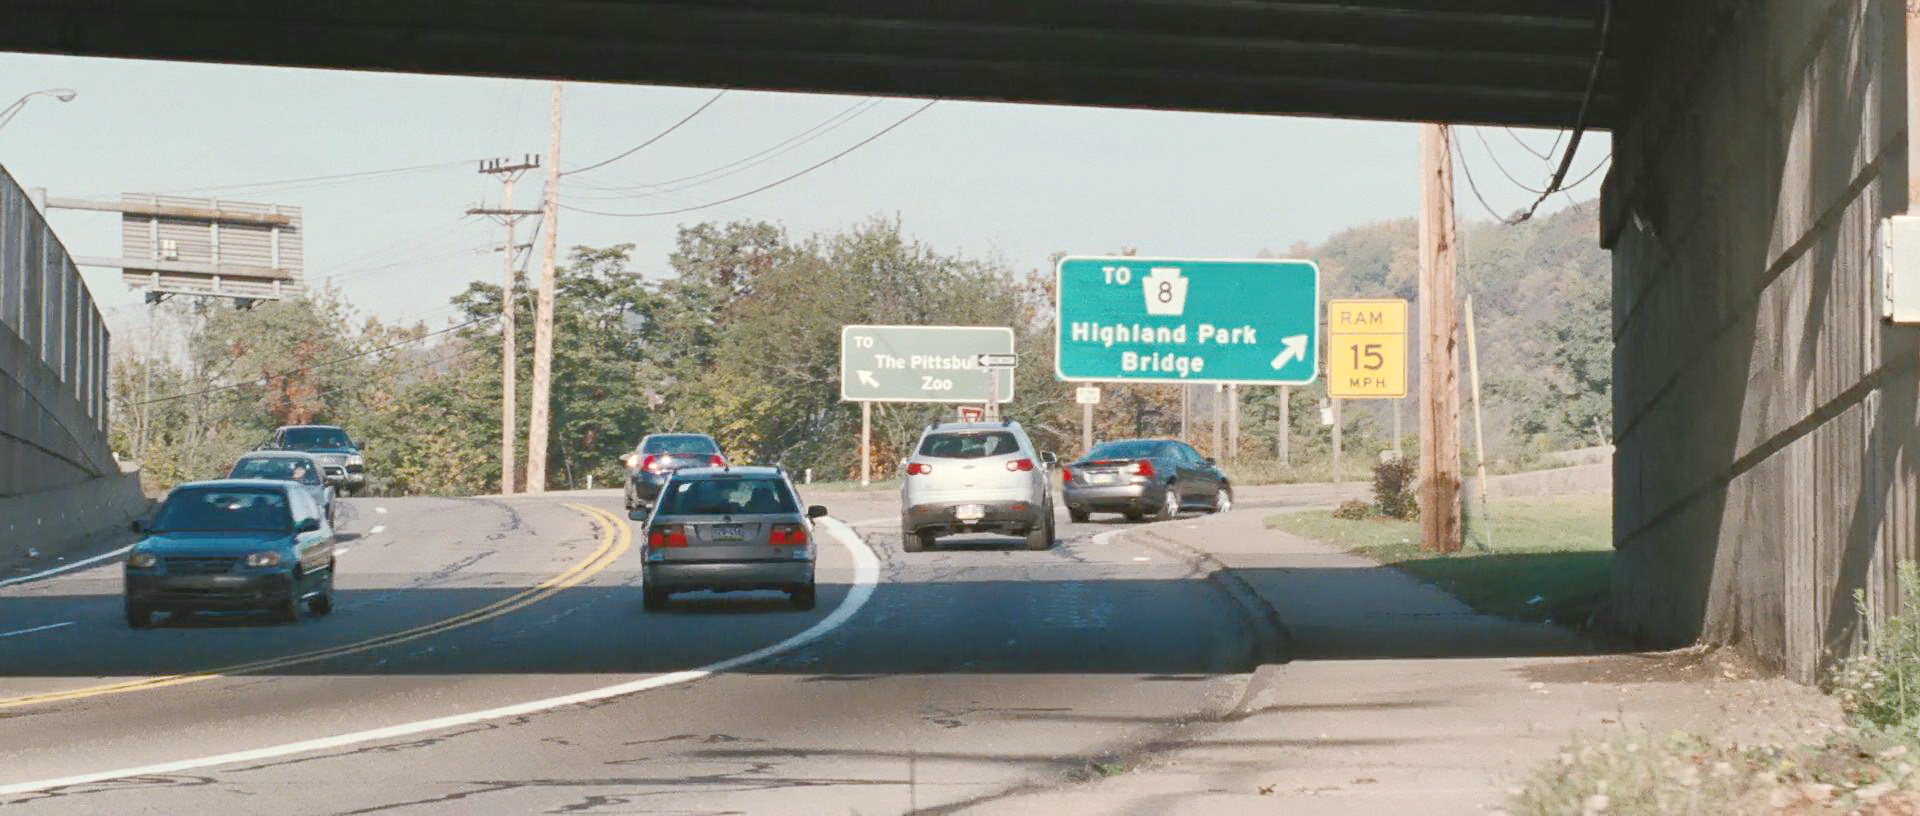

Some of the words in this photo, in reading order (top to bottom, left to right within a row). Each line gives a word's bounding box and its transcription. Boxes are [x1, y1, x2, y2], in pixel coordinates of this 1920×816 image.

[1102, 267, 1132, 285] TO
[1158, 281, 1172, 303] 8
[854, 336, 874, 348] TO
[1071, 321, 1187, 348] Highland
[1198, 323, 1257, 345] Park
[875, 354, 906, 369] The
[911, 355, 982, 372] Pittsbu
[1121, 351, 1204, 378] Bridge
[1350, 344, 1384, 371] 15
[921, 376, 953, 391] Zoo
[1349, 377, 1386, 389] MPH
